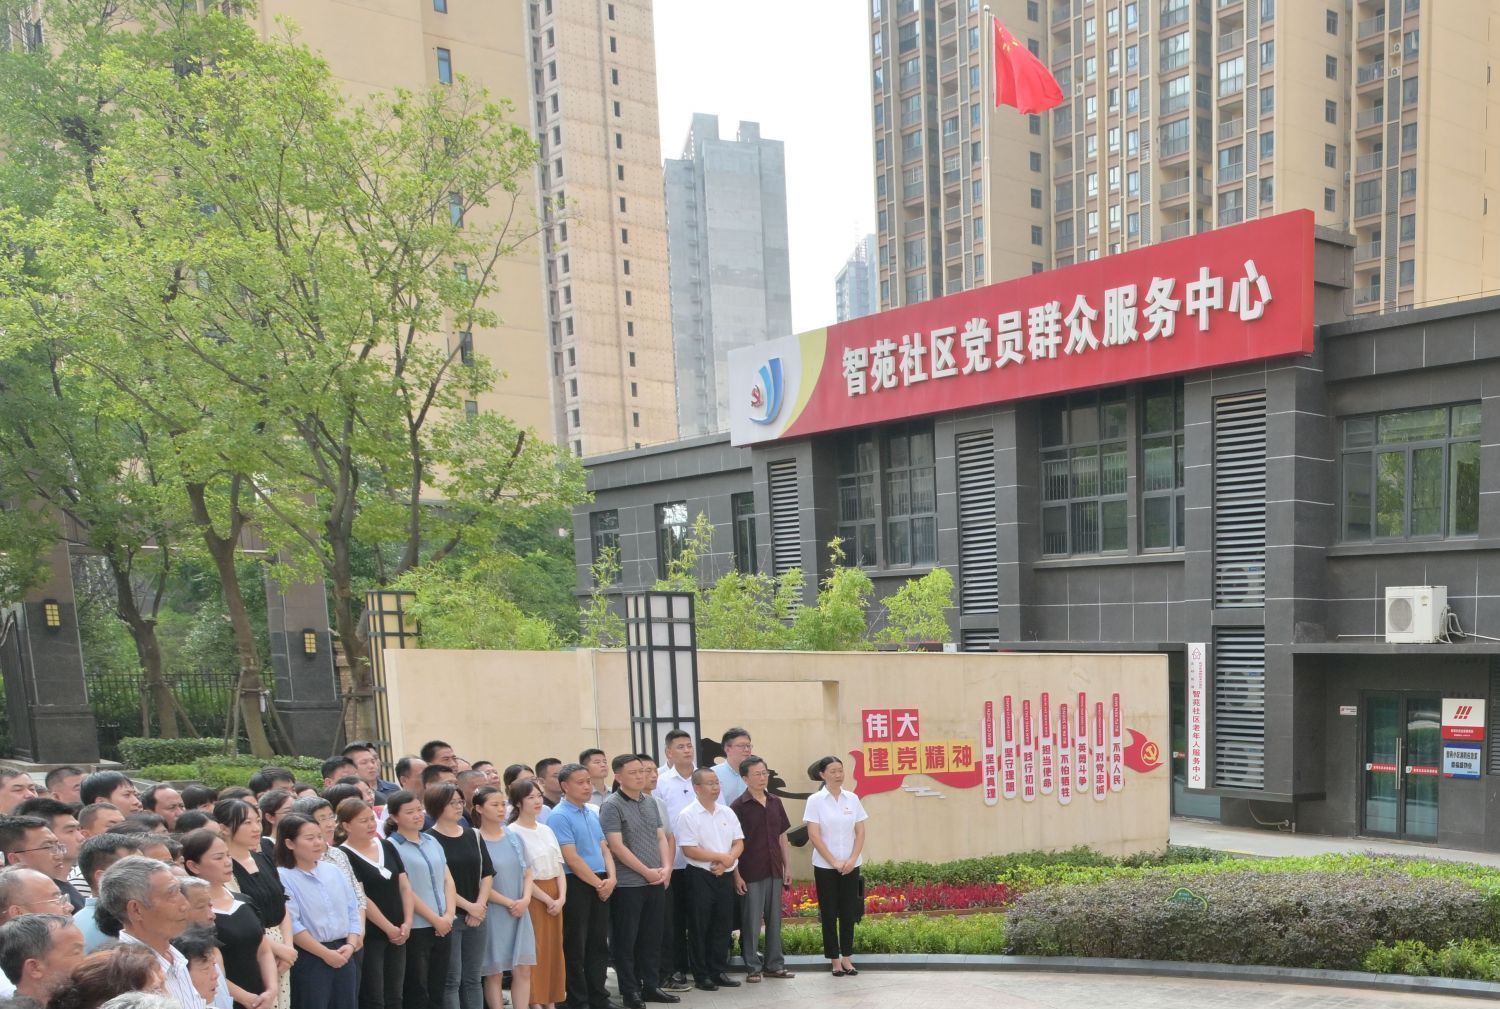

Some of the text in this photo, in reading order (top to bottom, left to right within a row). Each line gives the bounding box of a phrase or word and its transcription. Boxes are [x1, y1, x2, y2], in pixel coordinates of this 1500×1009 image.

[842, 259, 1273, 397] 智苑社区党员群众服务中心
[866, 713, 918, 738] 伟大
[1192, 690, 1200, 782] 智苑社区老年人服务中心
[868, 745, 972, 772] 建党精神
[985, 754, 996, 799] 坚持真理
[1005, 748, 1015, 792] 坚守理想
[1024, 752, 1034, 796] 践行初心
[1042, 745, 1052, 788] 担当使命
[1060, 754, 1070, 797] 不怕牺牲
[1078, 743, 1087, 785] 英勇斗争
[1096, 753, 1105, 795] 对党忠诚
[1113, 743, 1121, 785] 不负人民
